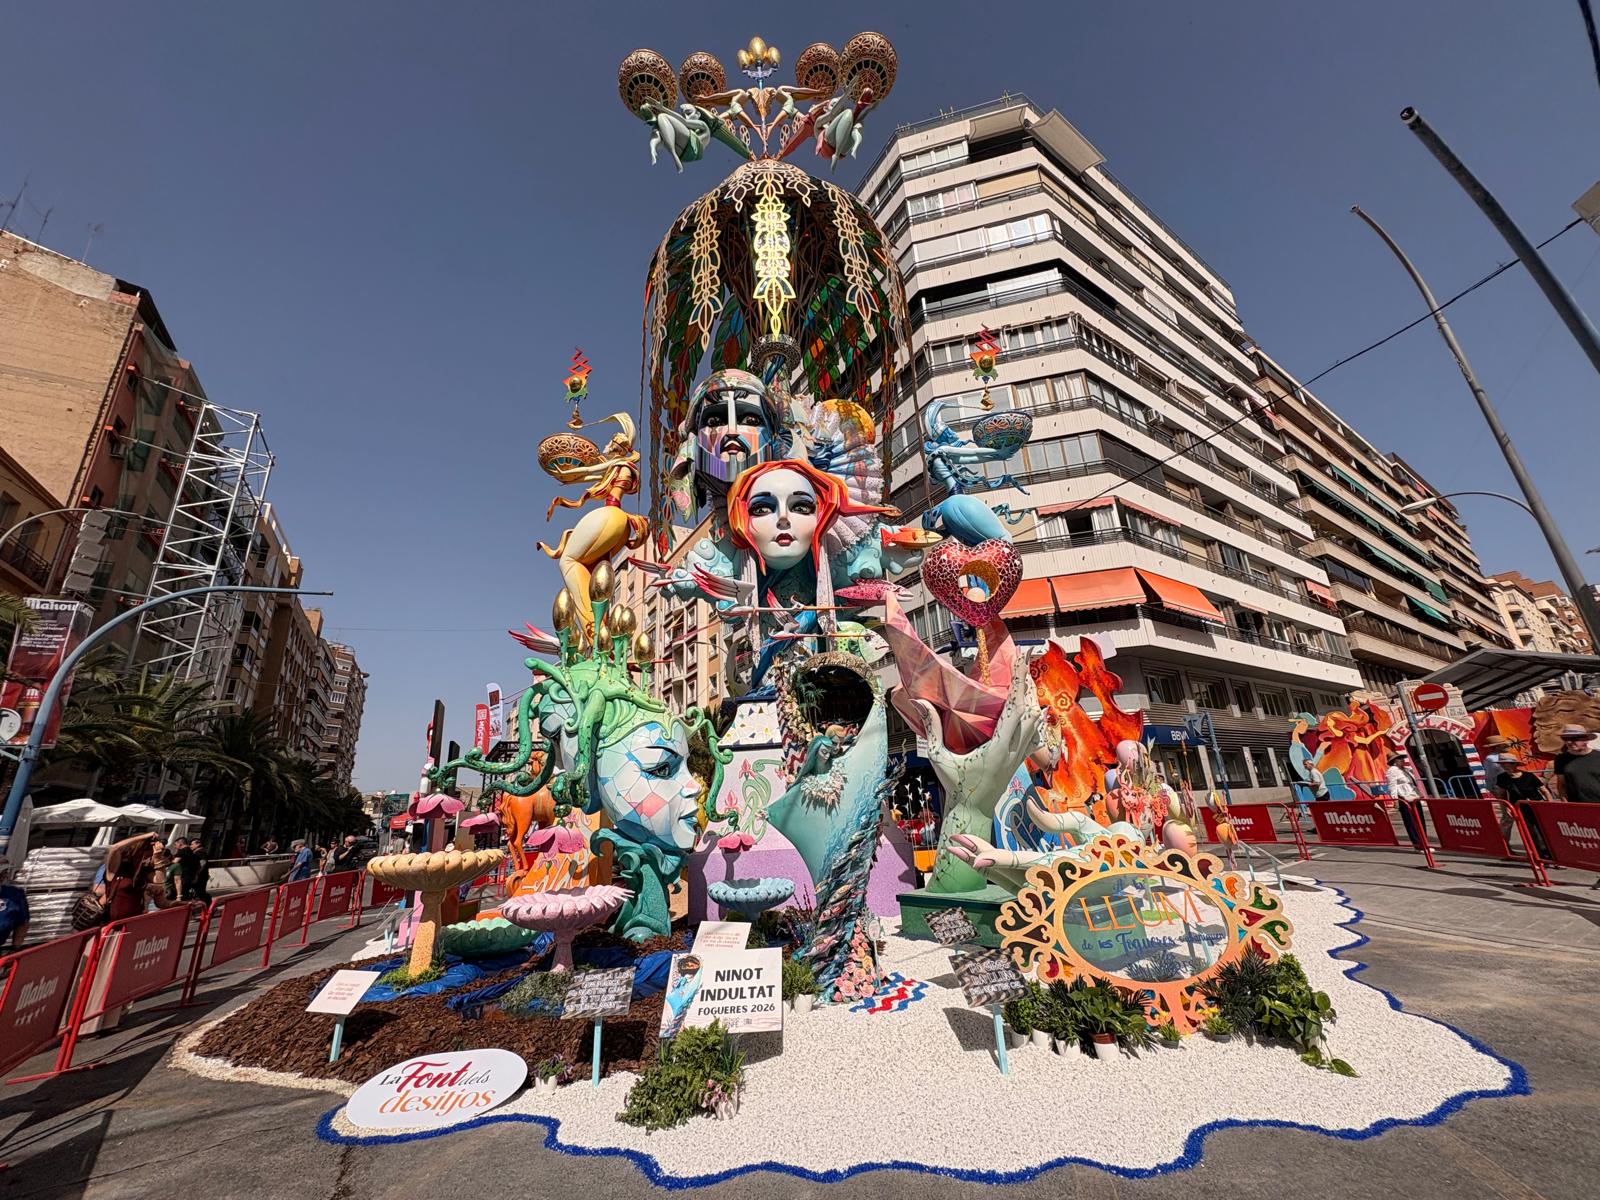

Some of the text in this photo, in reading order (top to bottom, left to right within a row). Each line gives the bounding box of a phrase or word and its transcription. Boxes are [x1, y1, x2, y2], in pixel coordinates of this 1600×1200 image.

[1170, 730, 1190, 741] BBVA
[1226, 816, 1254, 825] ahou
[1324, 811, 1376, 825] Mahou
[1446, 814, 1482, 829] Mahou
[1557, 821, 1600, 840] Mahou
[1078, 888, 1204, 932] LLUM
[233, 911, 258, 929] Mahou
[132, 936, 170, 960] Mahou
[714, 967, 764, 982] NINOT
[14, 975, 60, 1013] Mahou
[699, 985, 776, 1002] INDULTAT
[697, 1002, 776, 1016] FOGUERES 2026
[379, 1061, 491, 1093] La Font dels
[378, 1088, 496, 1116] desitjos
